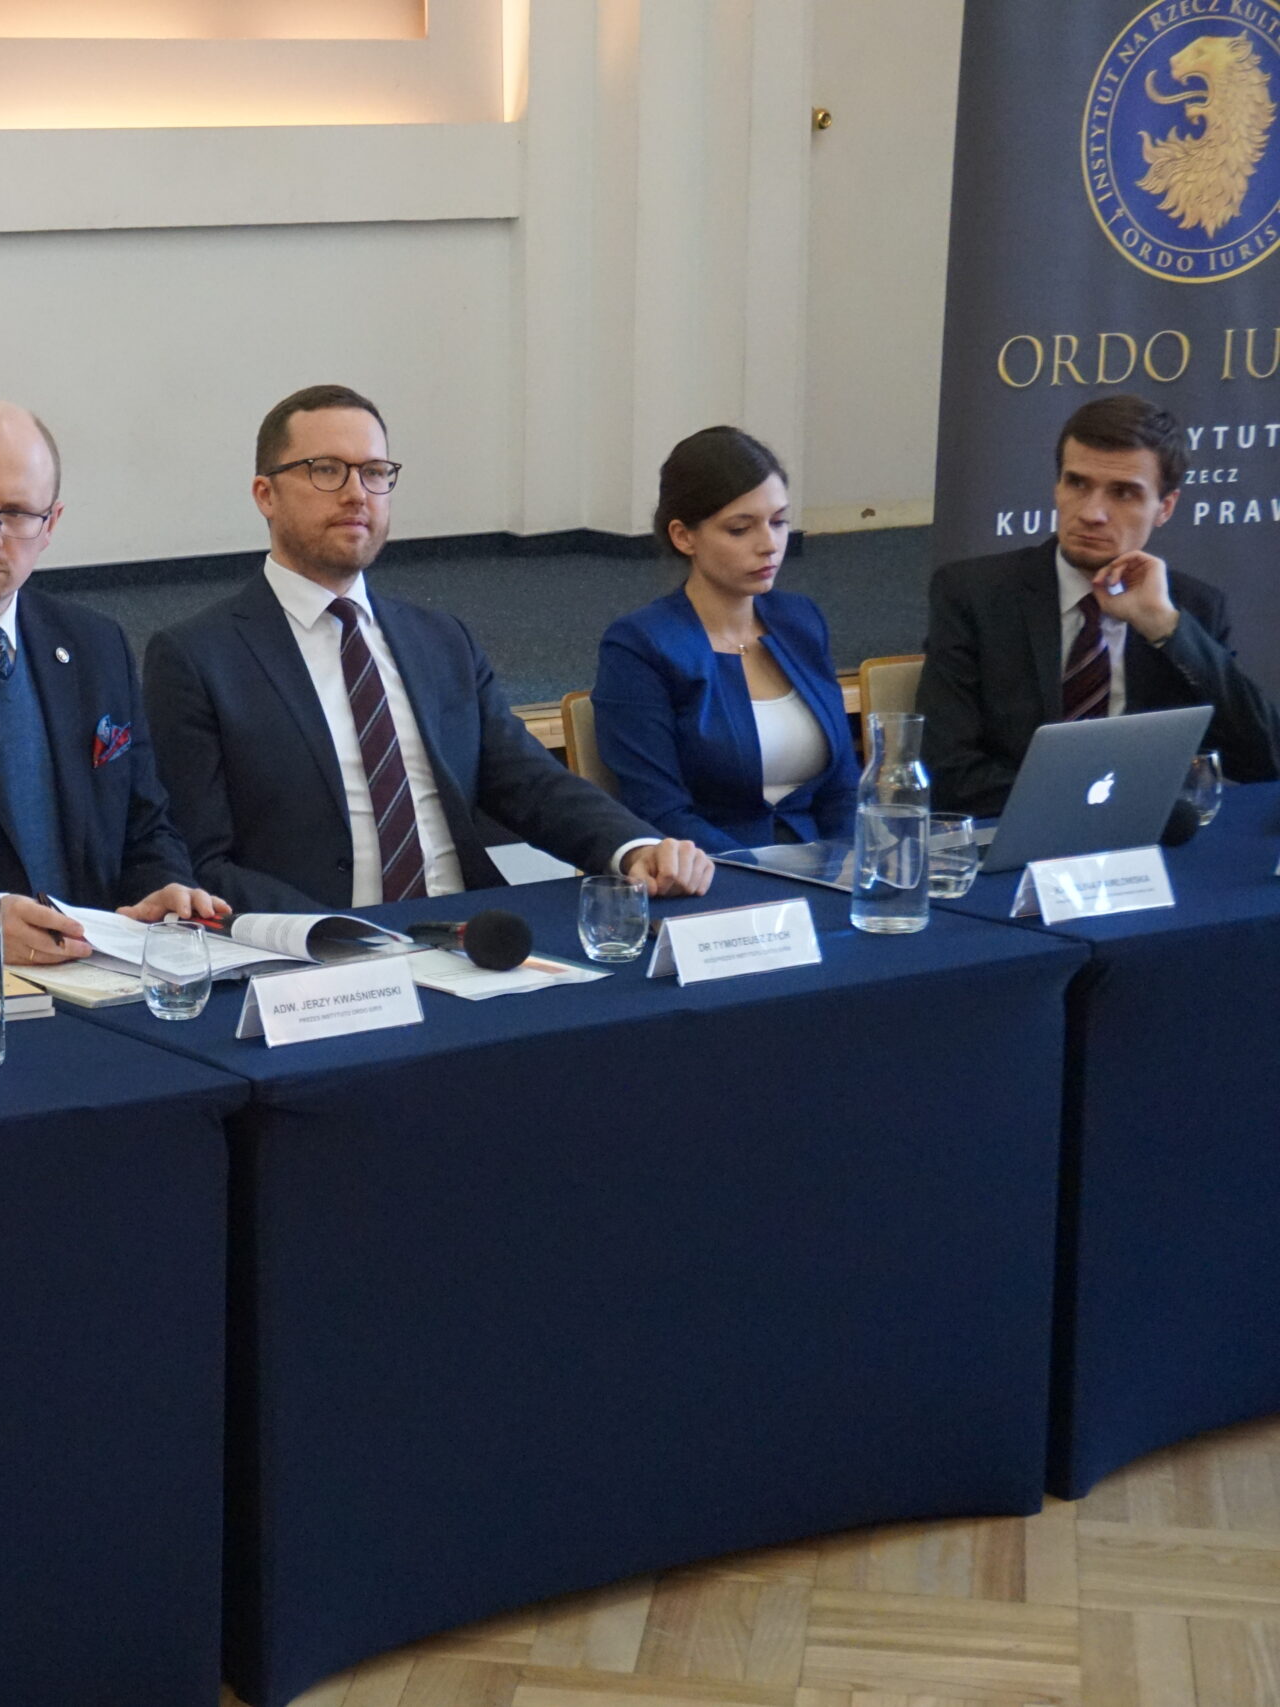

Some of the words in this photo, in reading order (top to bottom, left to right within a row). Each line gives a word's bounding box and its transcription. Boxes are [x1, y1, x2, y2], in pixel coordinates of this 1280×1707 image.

[1090, 68, 1119, 202] INSTYTUT
[1118, 33, 1147, 64] NA
[1149, 0, 1220, 32] RZECZ
[1229, 0, 1280, 42] KULT
[1122, 228, 1194, 272] ORDO
[1209, 225, 1277, 271] IURIS
[998, 329, 1191, 388] ORDO
[1186, 423, 1280, 451] YTUT
[1184, 468, 1239, 485] ZECZ
[273, 1002, 299, 1015] ADW.
[301, 997, 331, 1010] JERZY
[333, 986, 403, 1006] KWAŚNIEWSKI
